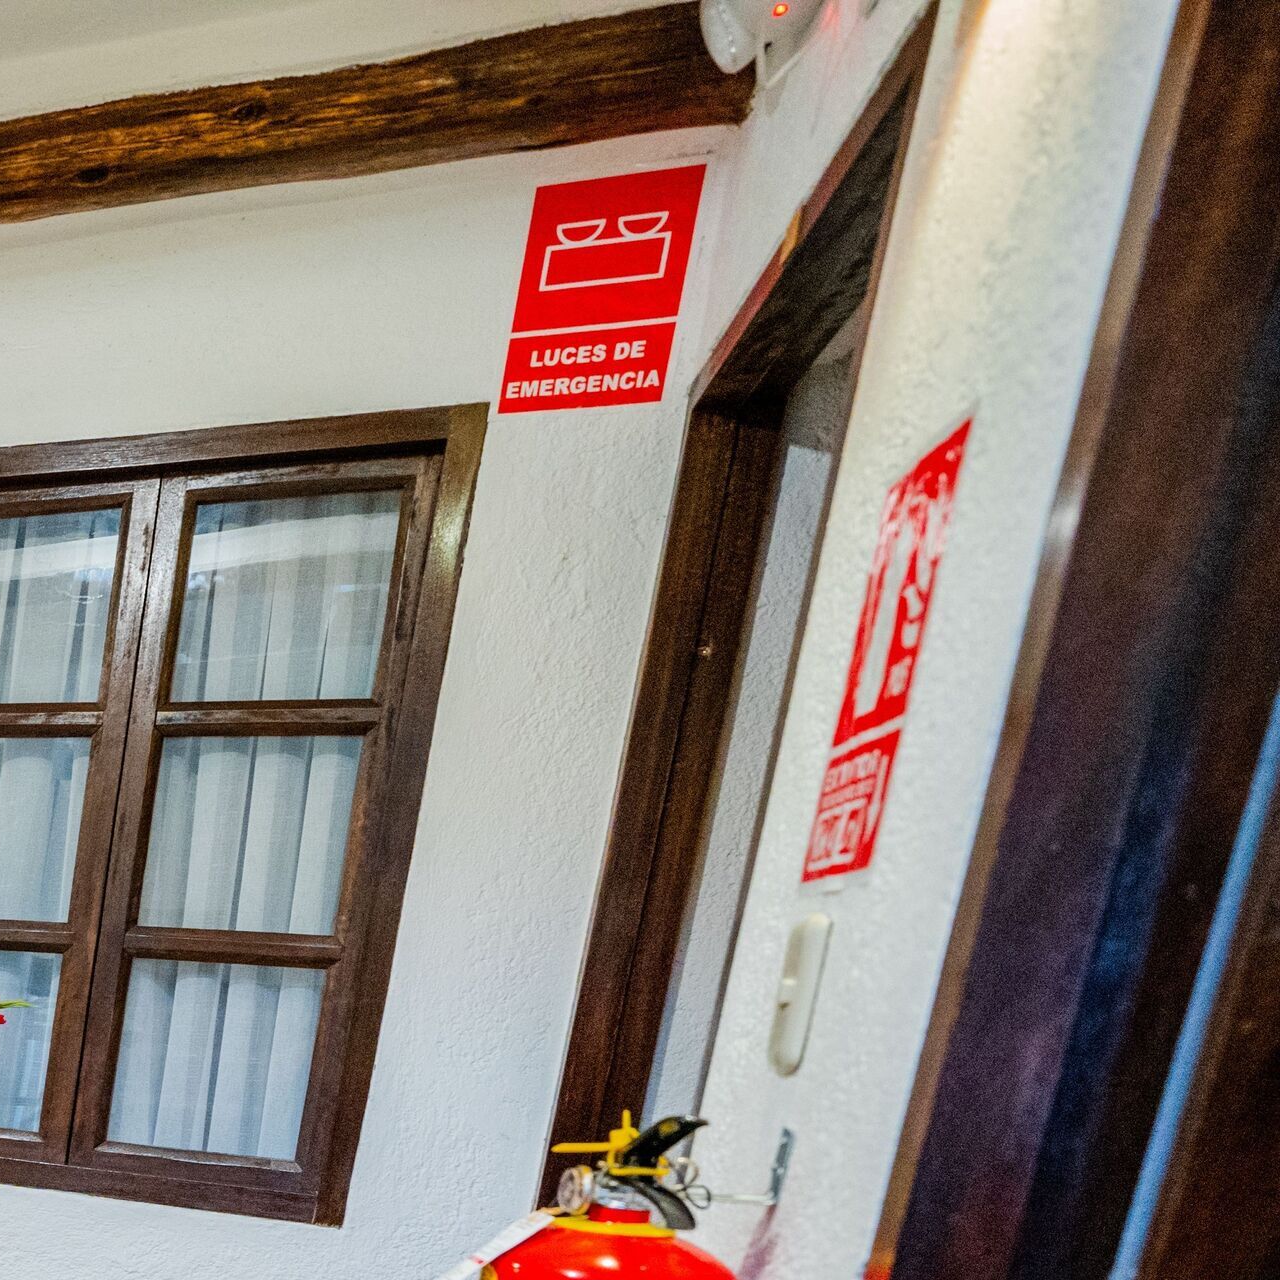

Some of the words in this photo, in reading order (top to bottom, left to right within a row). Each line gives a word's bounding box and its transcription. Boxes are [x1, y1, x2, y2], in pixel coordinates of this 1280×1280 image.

[529, 344, 607, 368] LUCES
[613, 340, 647, 361] DE
[505, 369, 660, 399] EMERGENCIA
